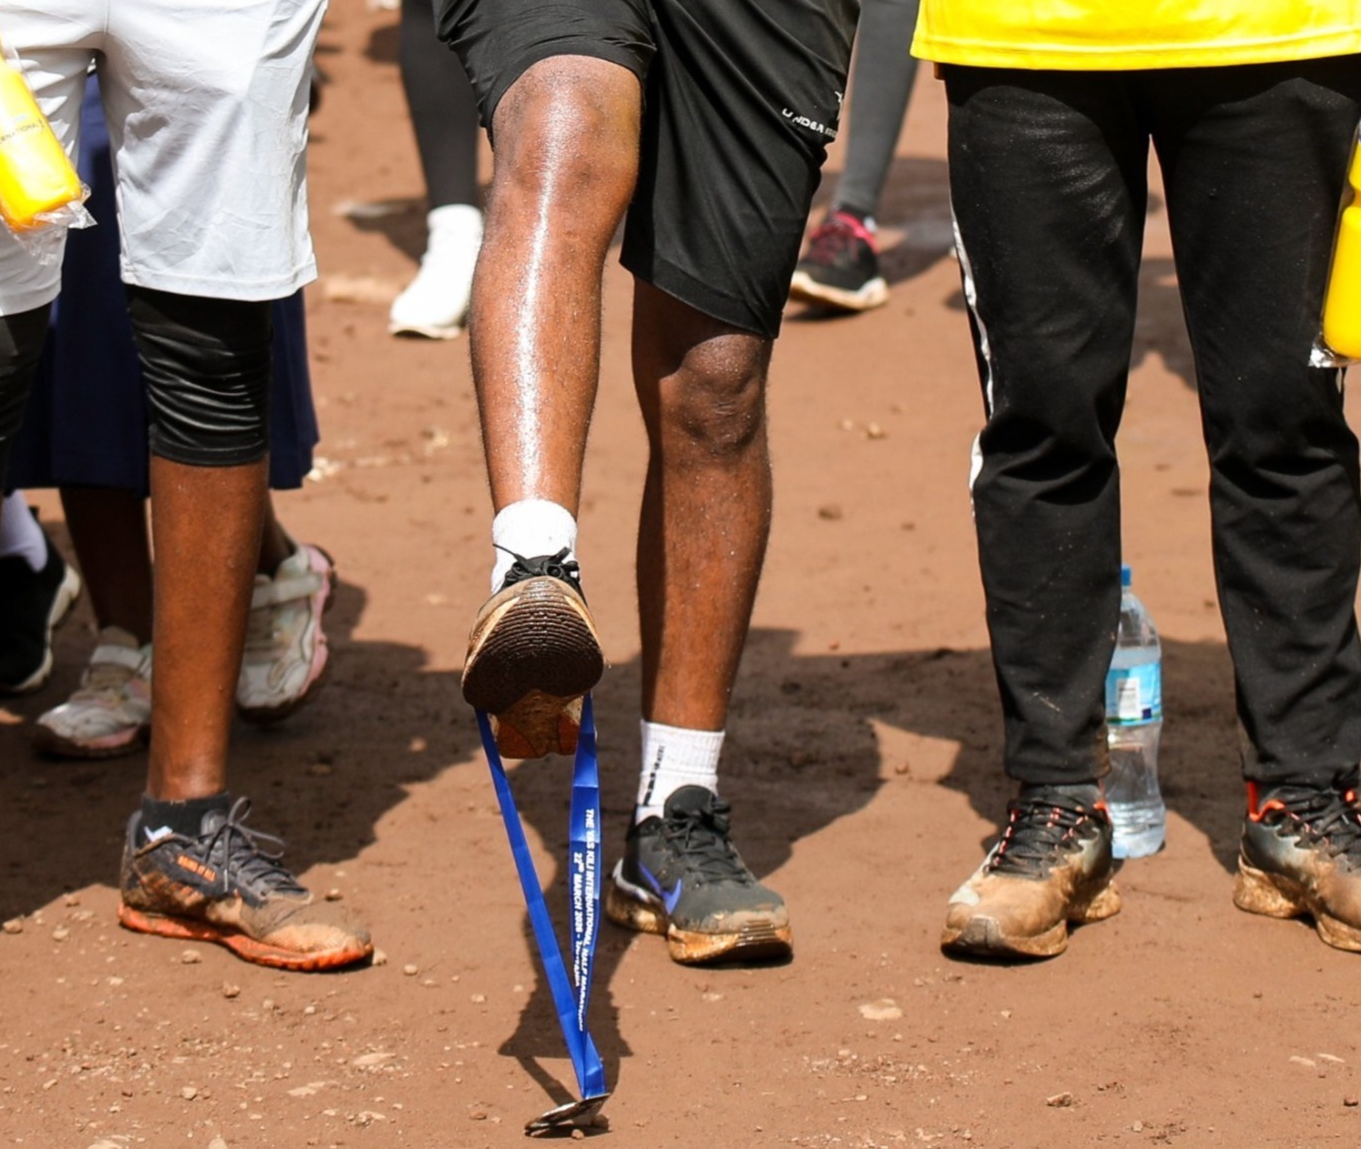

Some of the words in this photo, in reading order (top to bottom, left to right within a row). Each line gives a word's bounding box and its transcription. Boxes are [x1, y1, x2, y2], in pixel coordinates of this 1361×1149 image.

[585, 809, 595, 828] THE
[586, 830, 595, 849] YAS
[586, 850, 595, 870] KILI
[573, 873, 583, 910] MARCH
[583, 870, 595, 946] INTERNATIONAL
[581, 948, 589, 976] HALF
